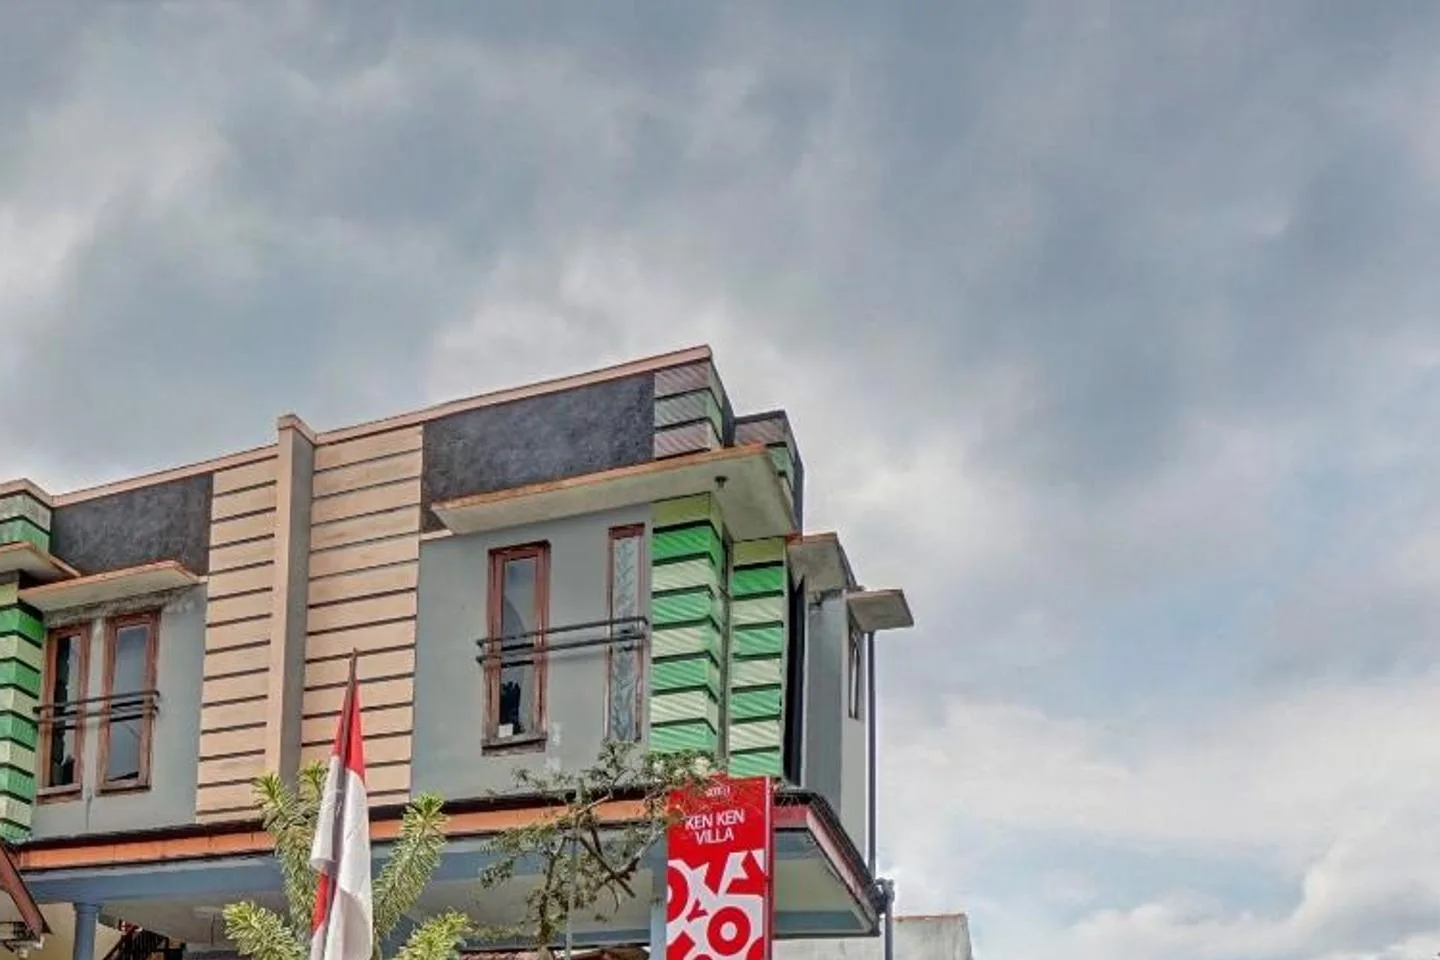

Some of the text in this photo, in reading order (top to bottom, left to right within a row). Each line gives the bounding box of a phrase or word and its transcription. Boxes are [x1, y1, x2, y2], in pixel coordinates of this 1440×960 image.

[685, 809, 745, 831] KEN KEN
[695, 827, 734, 845] VILLA
